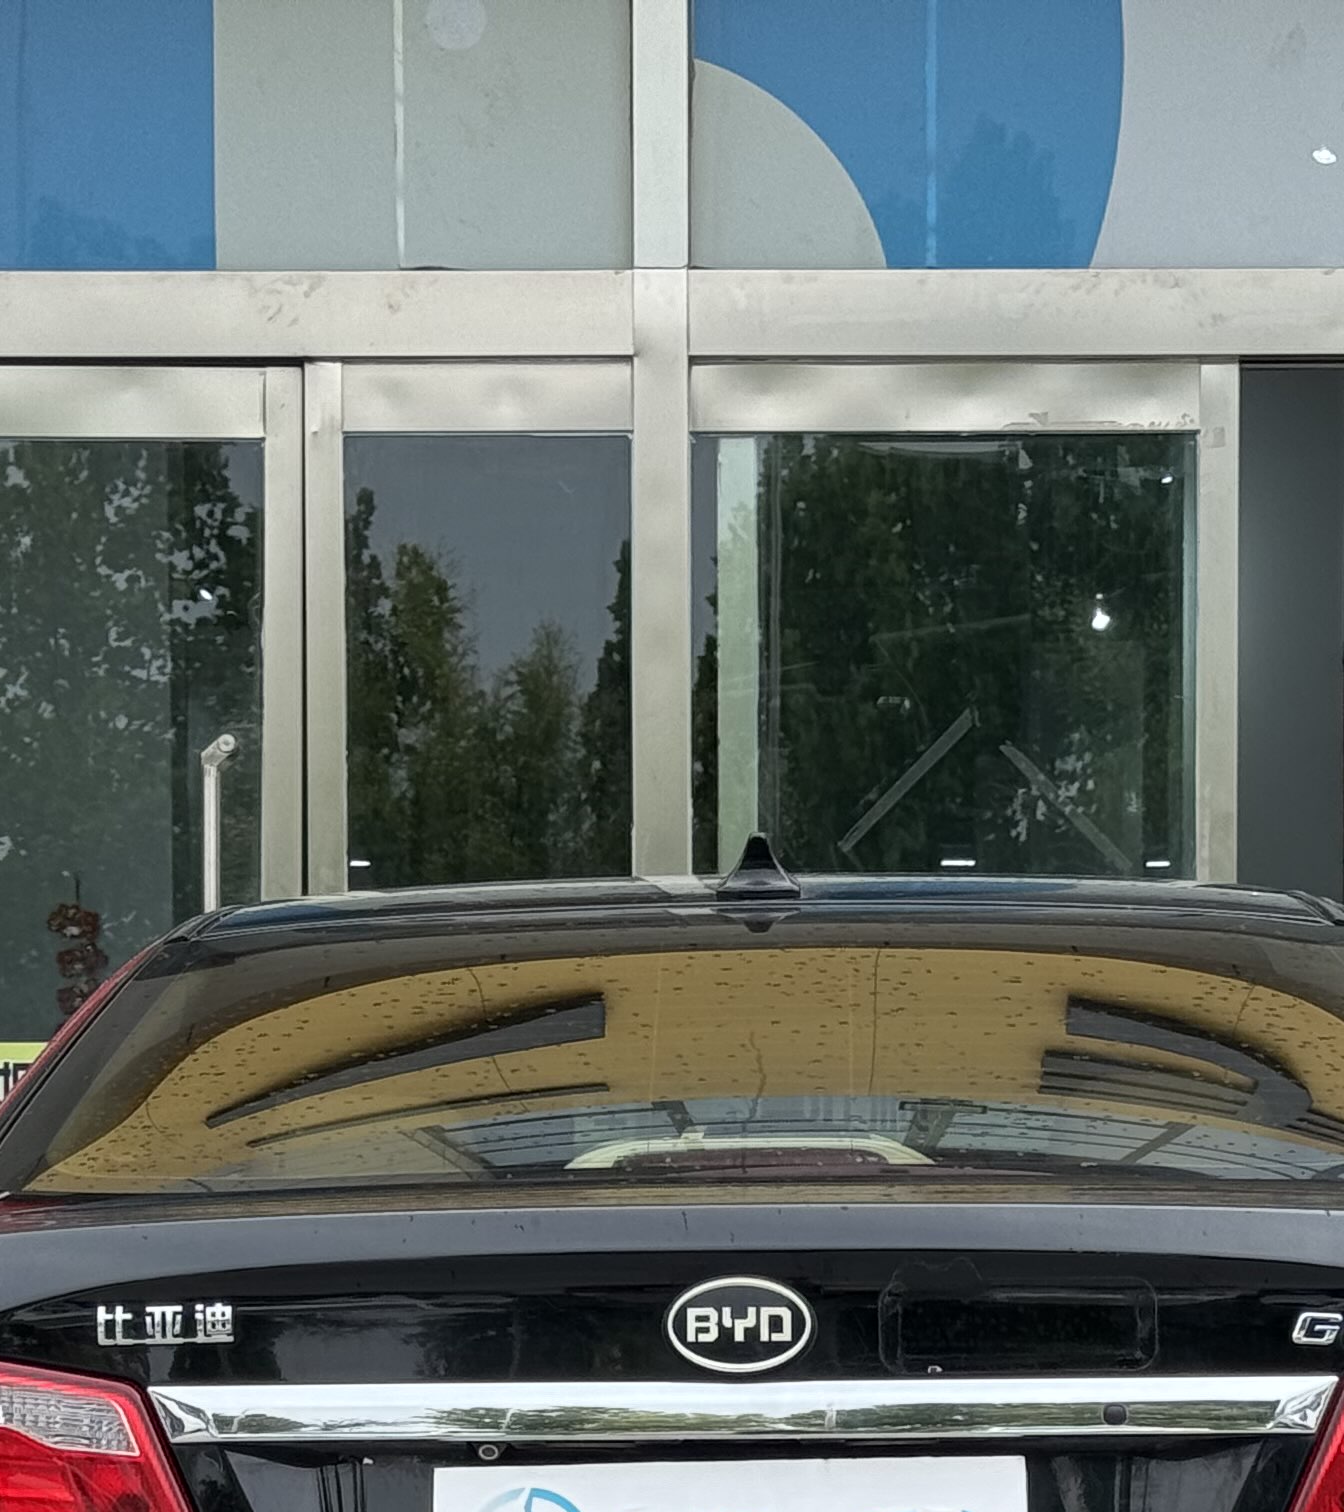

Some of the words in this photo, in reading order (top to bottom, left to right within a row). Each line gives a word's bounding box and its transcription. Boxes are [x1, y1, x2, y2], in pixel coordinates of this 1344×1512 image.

[96, 1302, 236, 1346] 比亚迪
[685, 1305, 794, 1344] BYD
